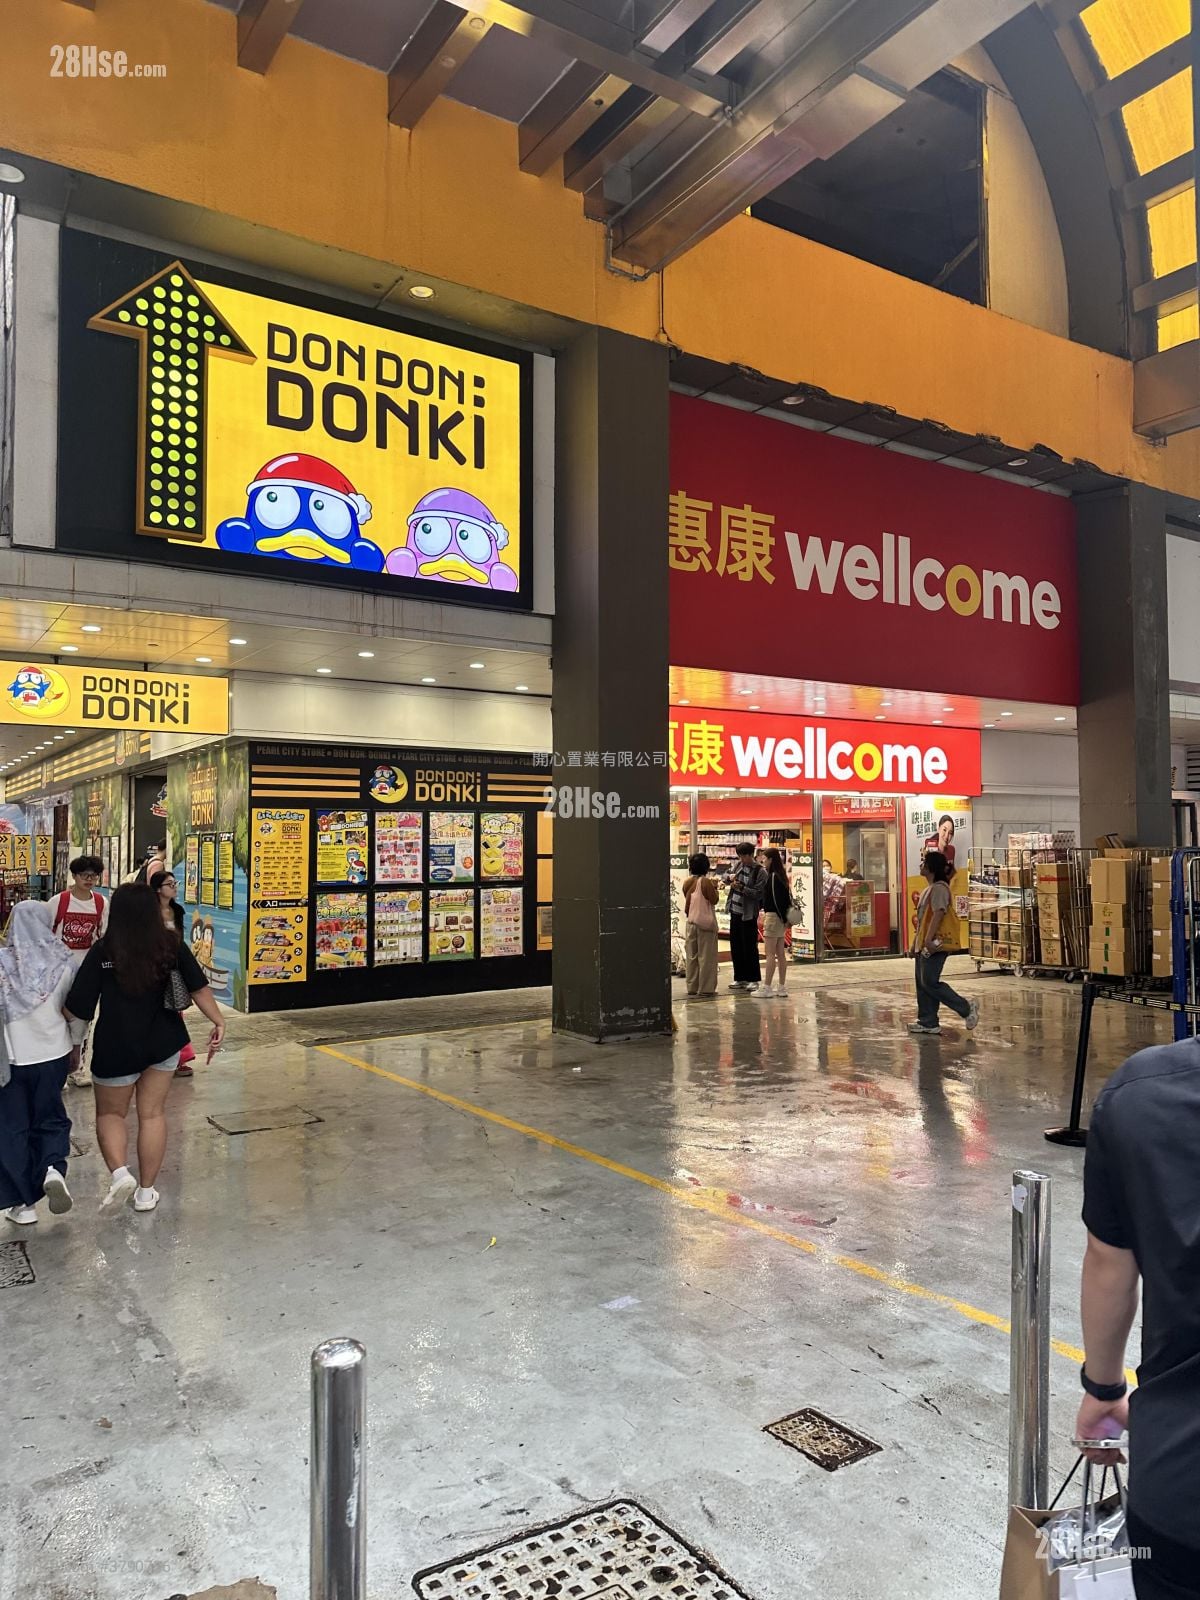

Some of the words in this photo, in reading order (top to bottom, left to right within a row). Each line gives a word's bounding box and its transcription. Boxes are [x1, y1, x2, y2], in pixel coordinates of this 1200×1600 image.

[669, 490, 775, 584] 惠康
[785, 533, 1062, 630] wellcome
[731, 727, 948, 784] wellcome
